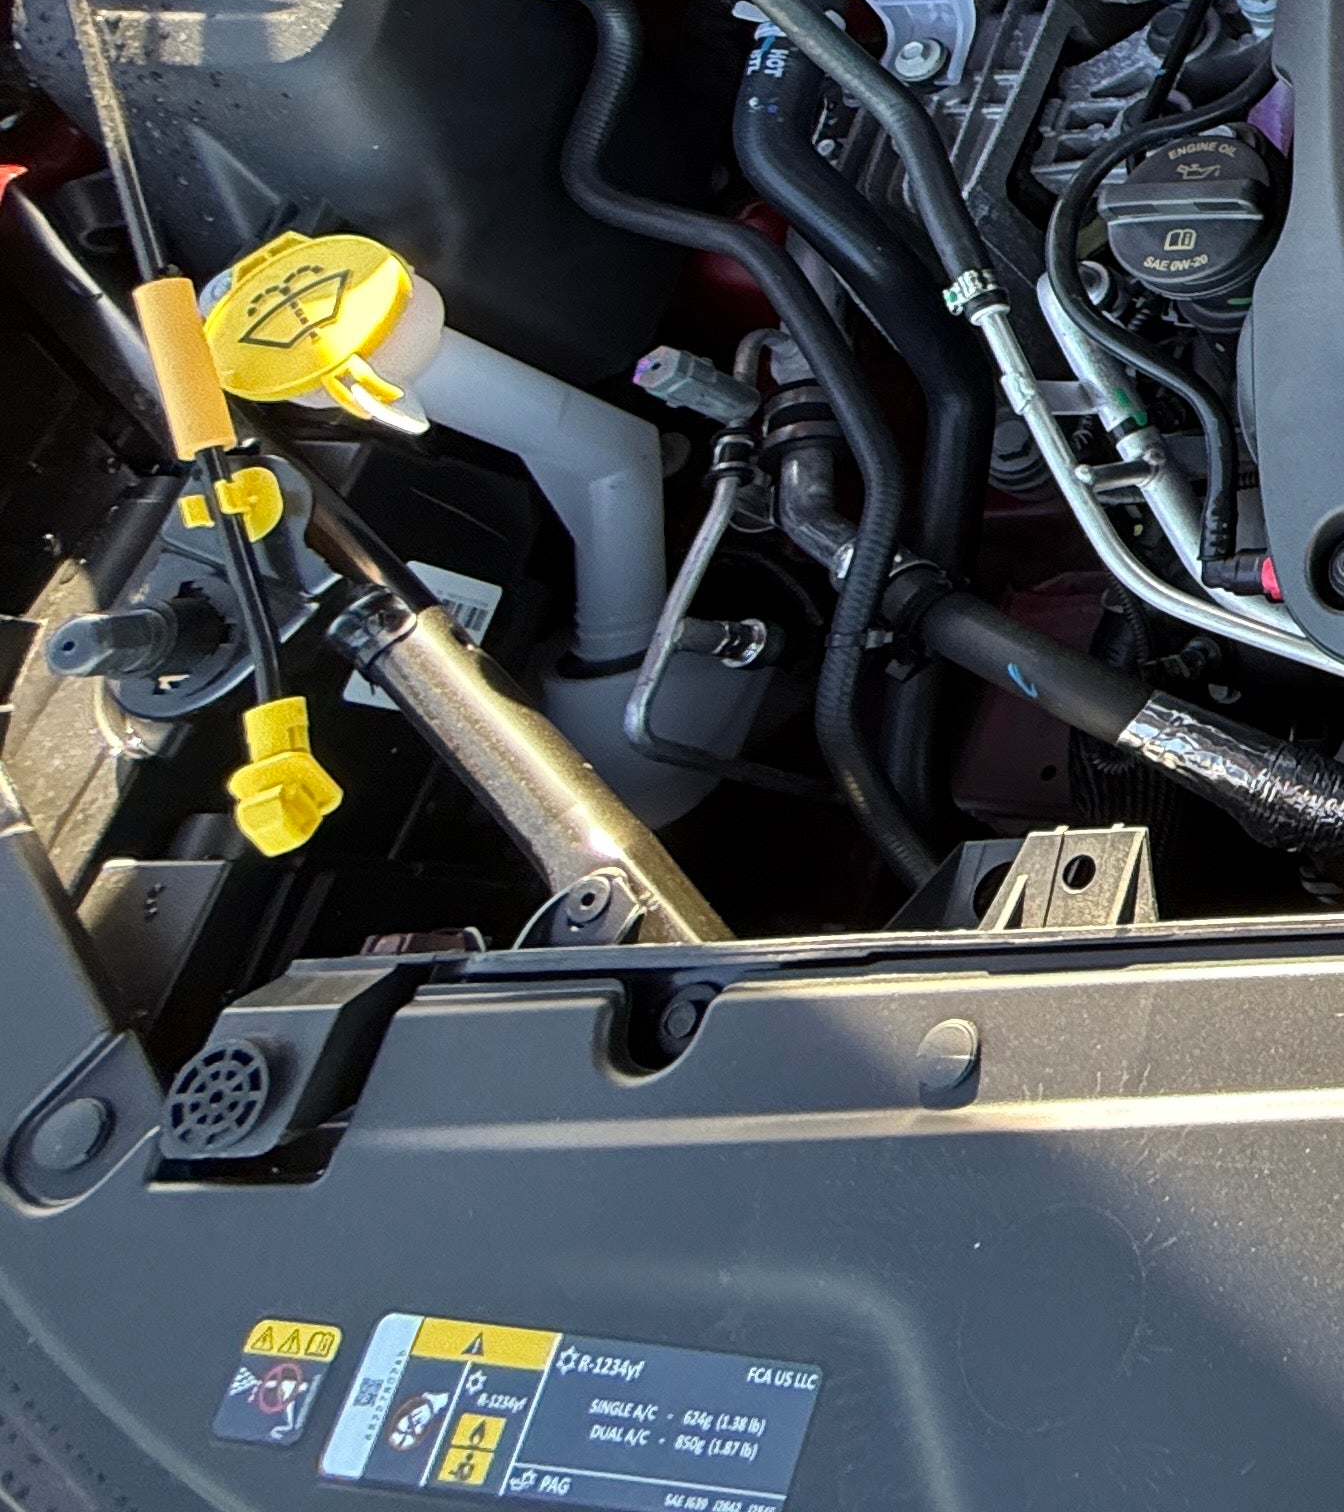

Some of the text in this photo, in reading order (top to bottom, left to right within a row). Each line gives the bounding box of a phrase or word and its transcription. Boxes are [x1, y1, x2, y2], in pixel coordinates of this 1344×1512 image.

[764, 48, 789, 78] HOT
[1168, 142, 1238, 160] ENGINE OIL
[1143, 254, 1208, 271] SAE 0W-20
[577, 1354, 645, 1381] R-1234yf
[747, 1367, 819, 1391] FCA US LLC
[588, 1398, 632, 1418] SINGLE
[633, 1403, 658, 1422] A/C
[683, 1410, 713, 1431] 624g
[715, 1412, 746, 1433] (1.38
[748, 1417, 767, 1437] lb)
[589, 1424, 624, 1442] DUAL
[624, 1428, 650, 1445] A/C
[674, 1434, 705, 1455] 850g
[708, 1437, 739, 1458] (1.87
[740, 1442, 759, 1461] lb)
[539, 1475, 571, 1495] PAG
[664, 1493, 685, 1507] SAE
